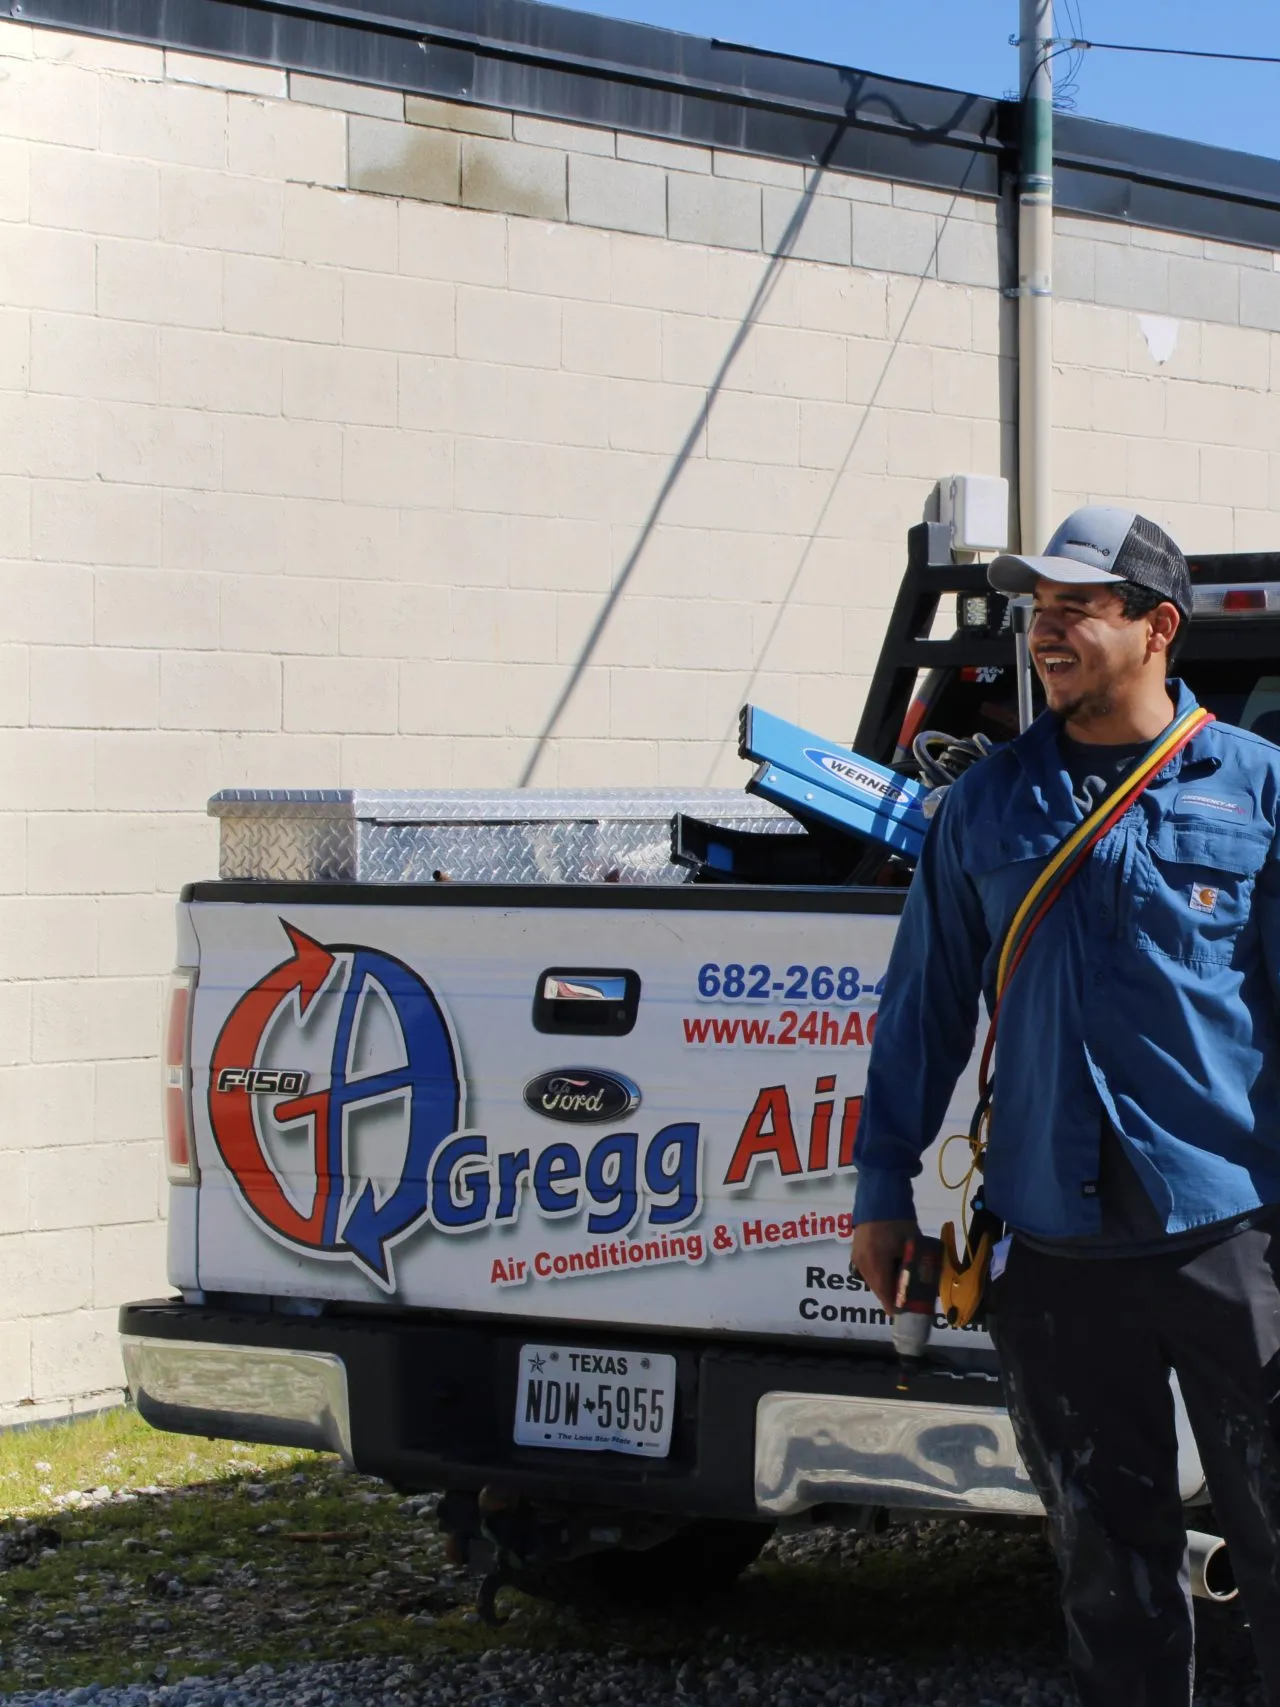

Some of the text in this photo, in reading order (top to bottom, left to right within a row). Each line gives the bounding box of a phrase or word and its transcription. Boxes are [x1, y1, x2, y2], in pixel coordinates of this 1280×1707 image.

[830, 760, 902, 800] WERNER
[698, 963, 887, 1001] 682-268-
[216, 1068, 309, 1096] F-150
[541, 1077, 605, 1112] Ford
[432, 1121, 701, 1235] Gregg
[490, 1211, 853, 1284] Air Conditioning & Heating
[568, 1353, 628, 1376] TEXAS
[525, 1379, 664, 1434] NDW 5955
[557, 1432, 573, 1440] The
[611, 1436, 631, 1444] State
